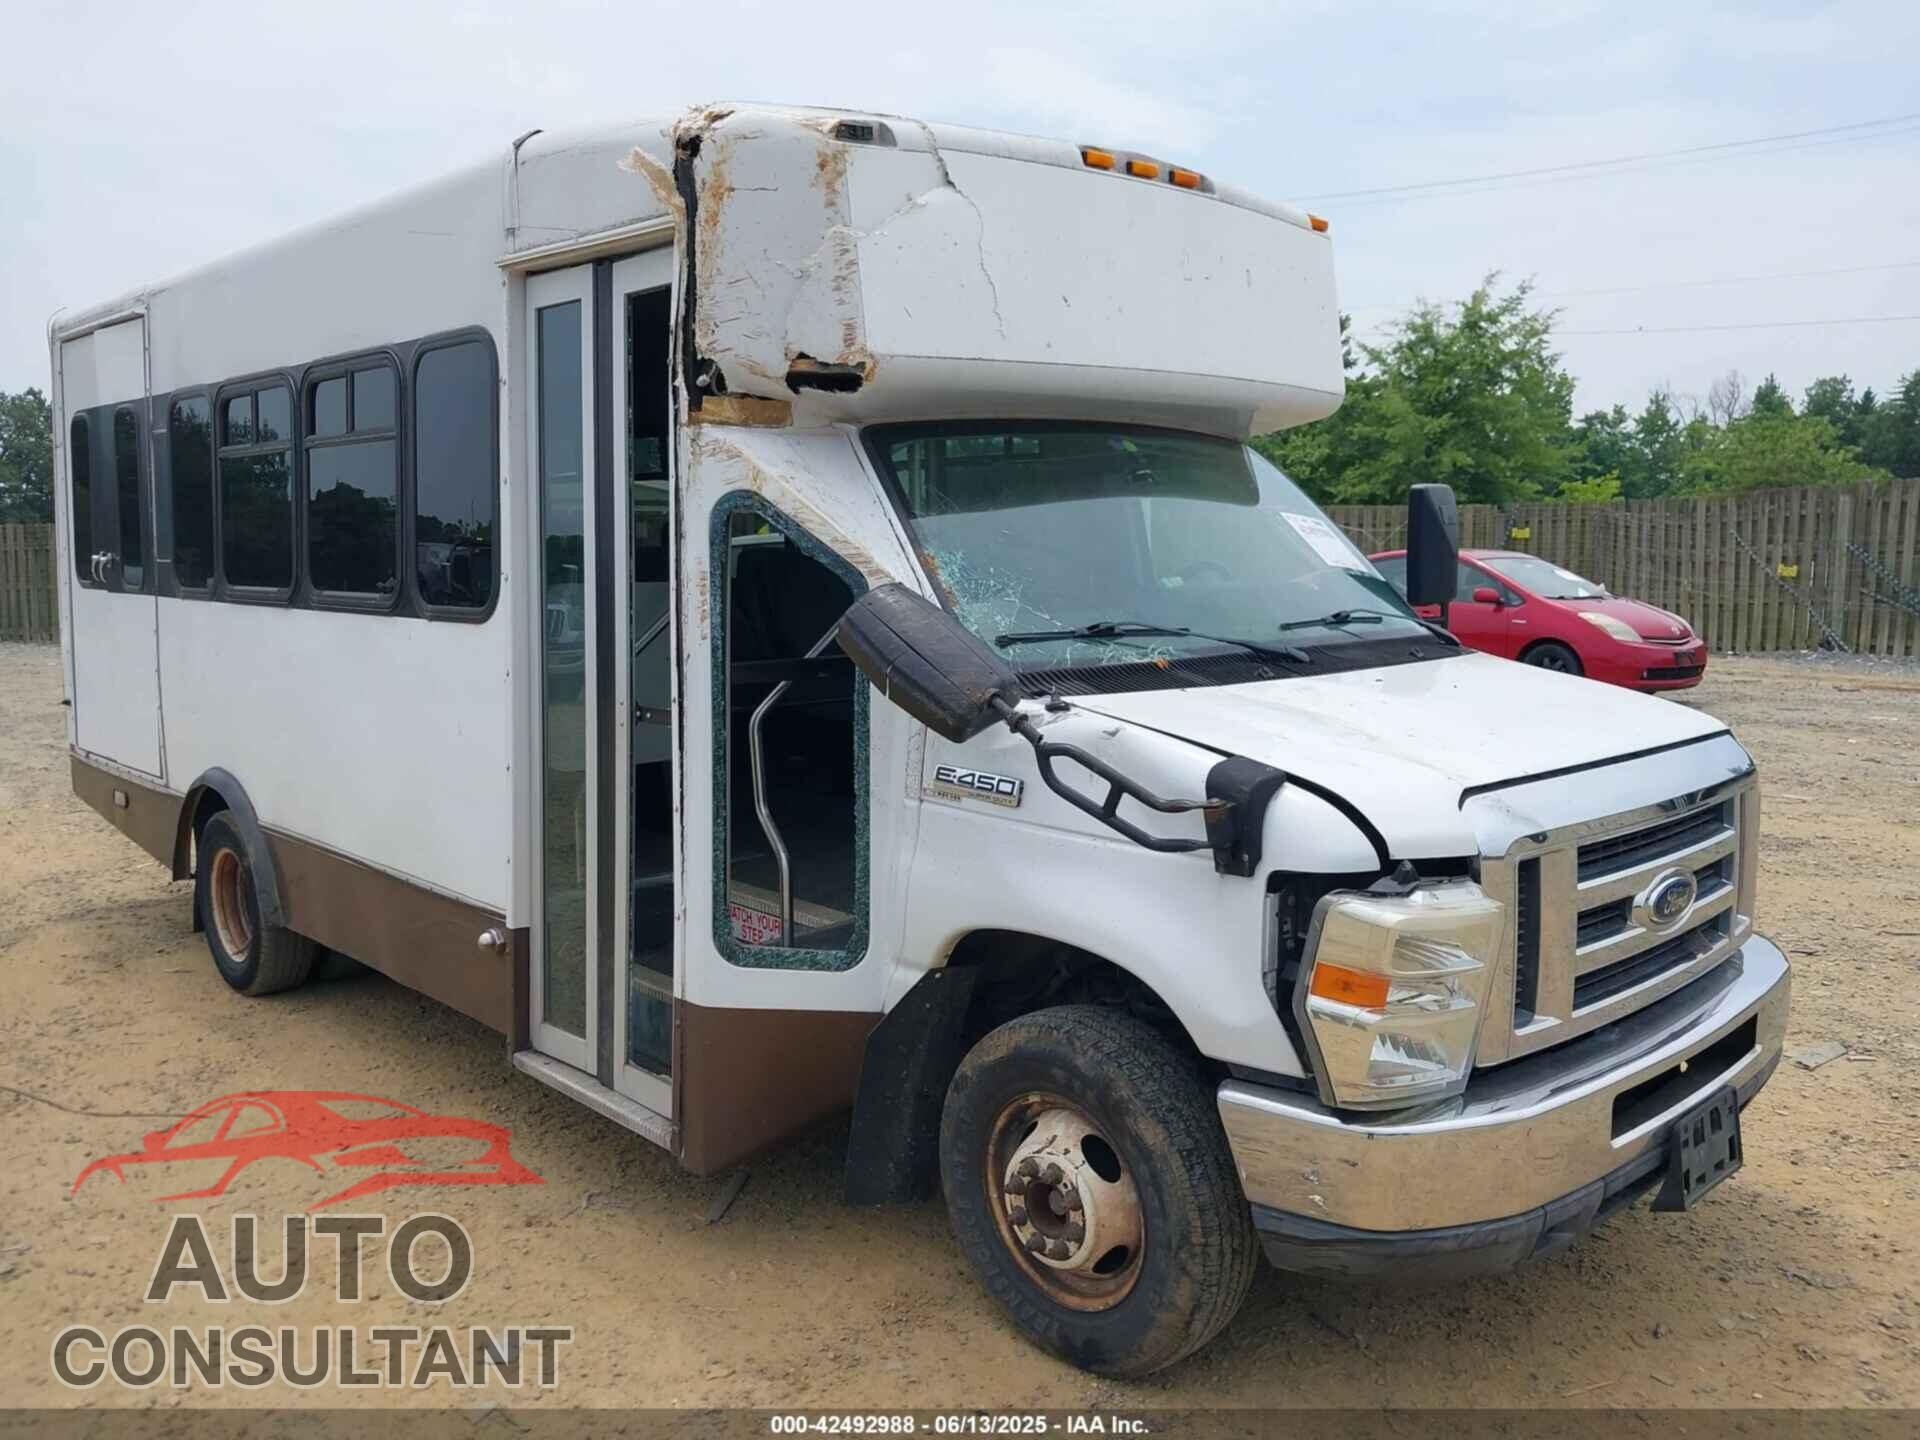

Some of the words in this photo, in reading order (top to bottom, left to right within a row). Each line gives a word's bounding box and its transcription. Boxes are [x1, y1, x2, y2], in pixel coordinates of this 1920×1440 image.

[729, 904, 753, 925] ATCH
[757, 913, 782, 933] YOUR
[741, 924, 764, 944] STEP
